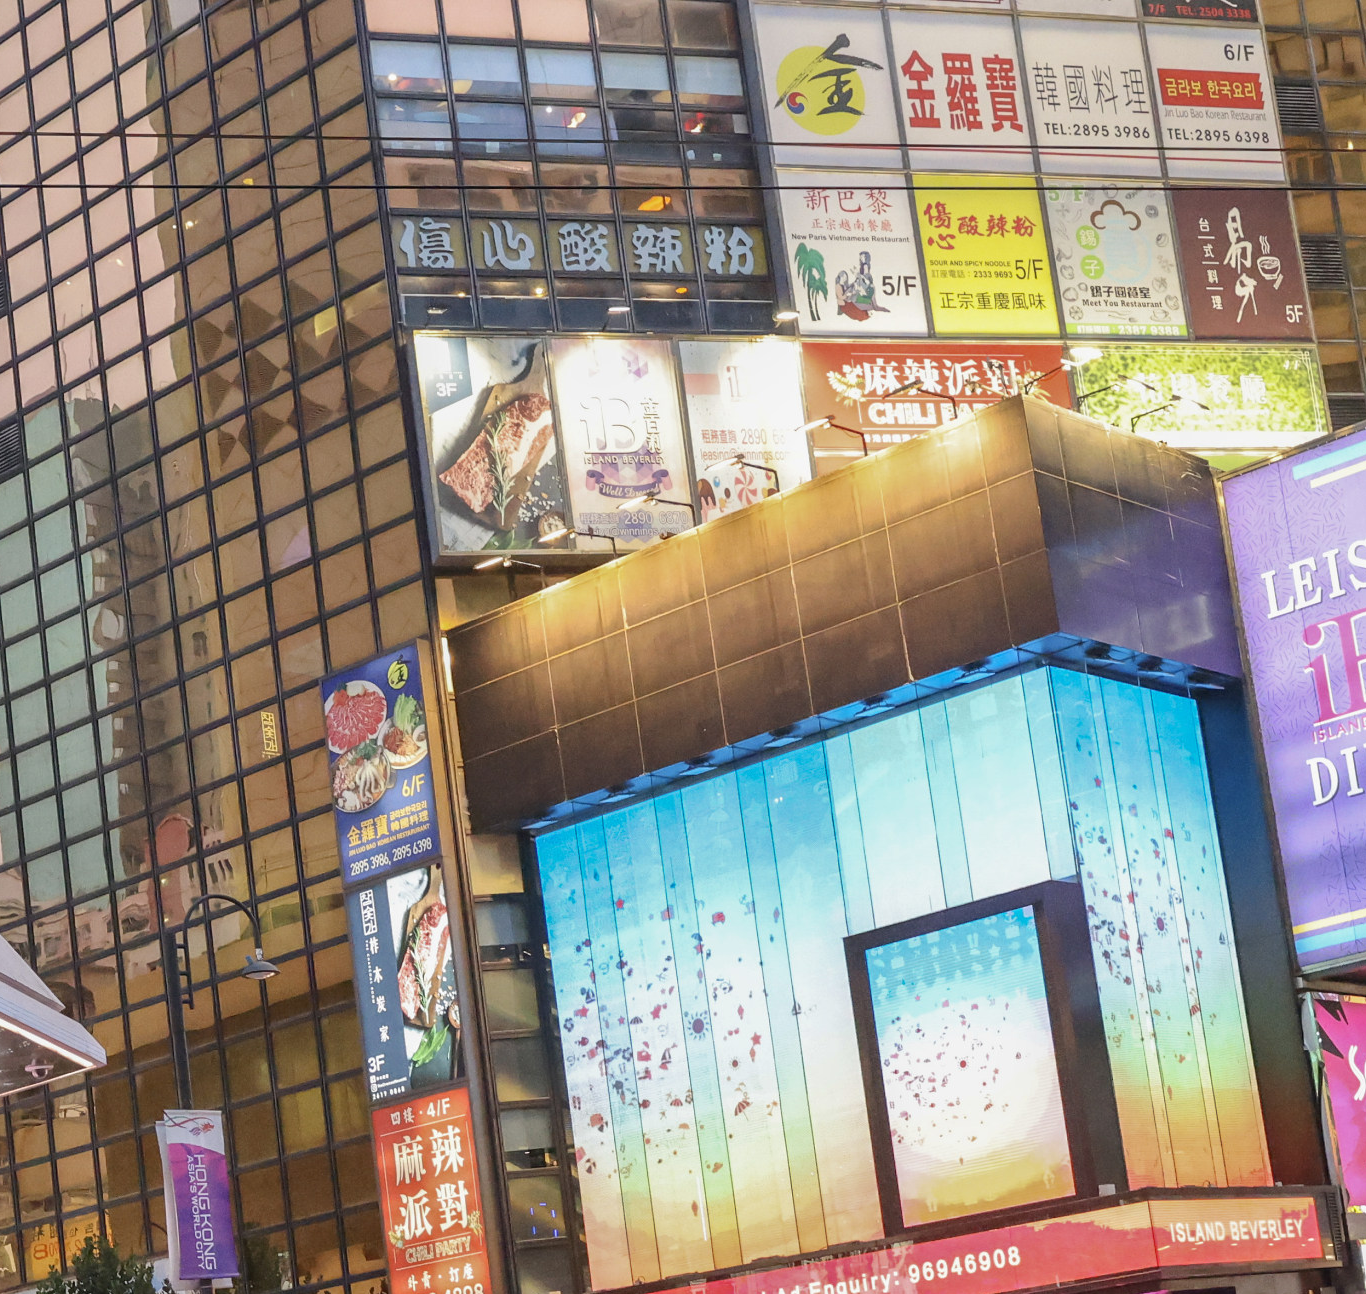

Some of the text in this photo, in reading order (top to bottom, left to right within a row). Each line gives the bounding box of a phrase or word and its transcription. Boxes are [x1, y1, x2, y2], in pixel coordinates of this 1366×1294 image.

[1224, 44, 1254, 61] 6/F
[901, 50, 1024, 133] 金羅寶
[1032, 61, 1150, 115] 韓國料理
[1165, 78, 1257, 100] 금라보 한국요리
[1164, 107, 1267, 121] Jin Luo Bao Korean Restaurant
[1044, 123, 1150, 139] TEL:2895 3986
[1167, 128, 1270, 144] TEL:2895 6398
[803, 188, 893, 215] 新巴黎
[811, 217, 893, 233] 正宗越南餐廳
[400, 217, 754, 275] 傷心酸辣粉
[791, 233, 807, 241] New
[829, 235, 869, 243] Vietnamese
[973, 270, 1013, 279] 2333 9693
[1015, 258, 1043, 280] 5/F
[1198, 217, 1223, 310] 台式料理
[882, 275, 916, 296] 5/F
[939, 292, 1046, 311] 正宗重慶風味
[1083, 299, 1162, 308] Meet You Restaurant
[1286, 305, 1303, 324] 5F
[863, 358, 1023, 396] 麻辣派對
[436, 382, 458, 398] 3F
[741, 429, 768, 445] 2890
[584, 455, 665, 465] ISLAND BEVERLEY
[623, 511, 653, 524] 2890
[401, 773, 426, 797] 6/F
[347, 814, 389, 847] 金羅寶
[350, 859, 369, 876] 2895
[392, 844, 411, 861] 2895
[413, 837, 432, 855] 6398
[368, 1054, 385, 1073] 3F
[427, 1098, 451, 1117] 4/F
[393, 1124, 465, 1187] 麻辣
[187, 1155, 205, 1270] ASIA'S WORLD CITY
[194, 1154, 217, 1270] HONG KONG
[399, 1180, 469, 1241] 派對
[1169, 1219, 1303, 1243] ISLAND BEVERLEY
[405, 1236, 471, 1263] CHILI PARTY
[908, 1246, 1021, 1284] 96946908
